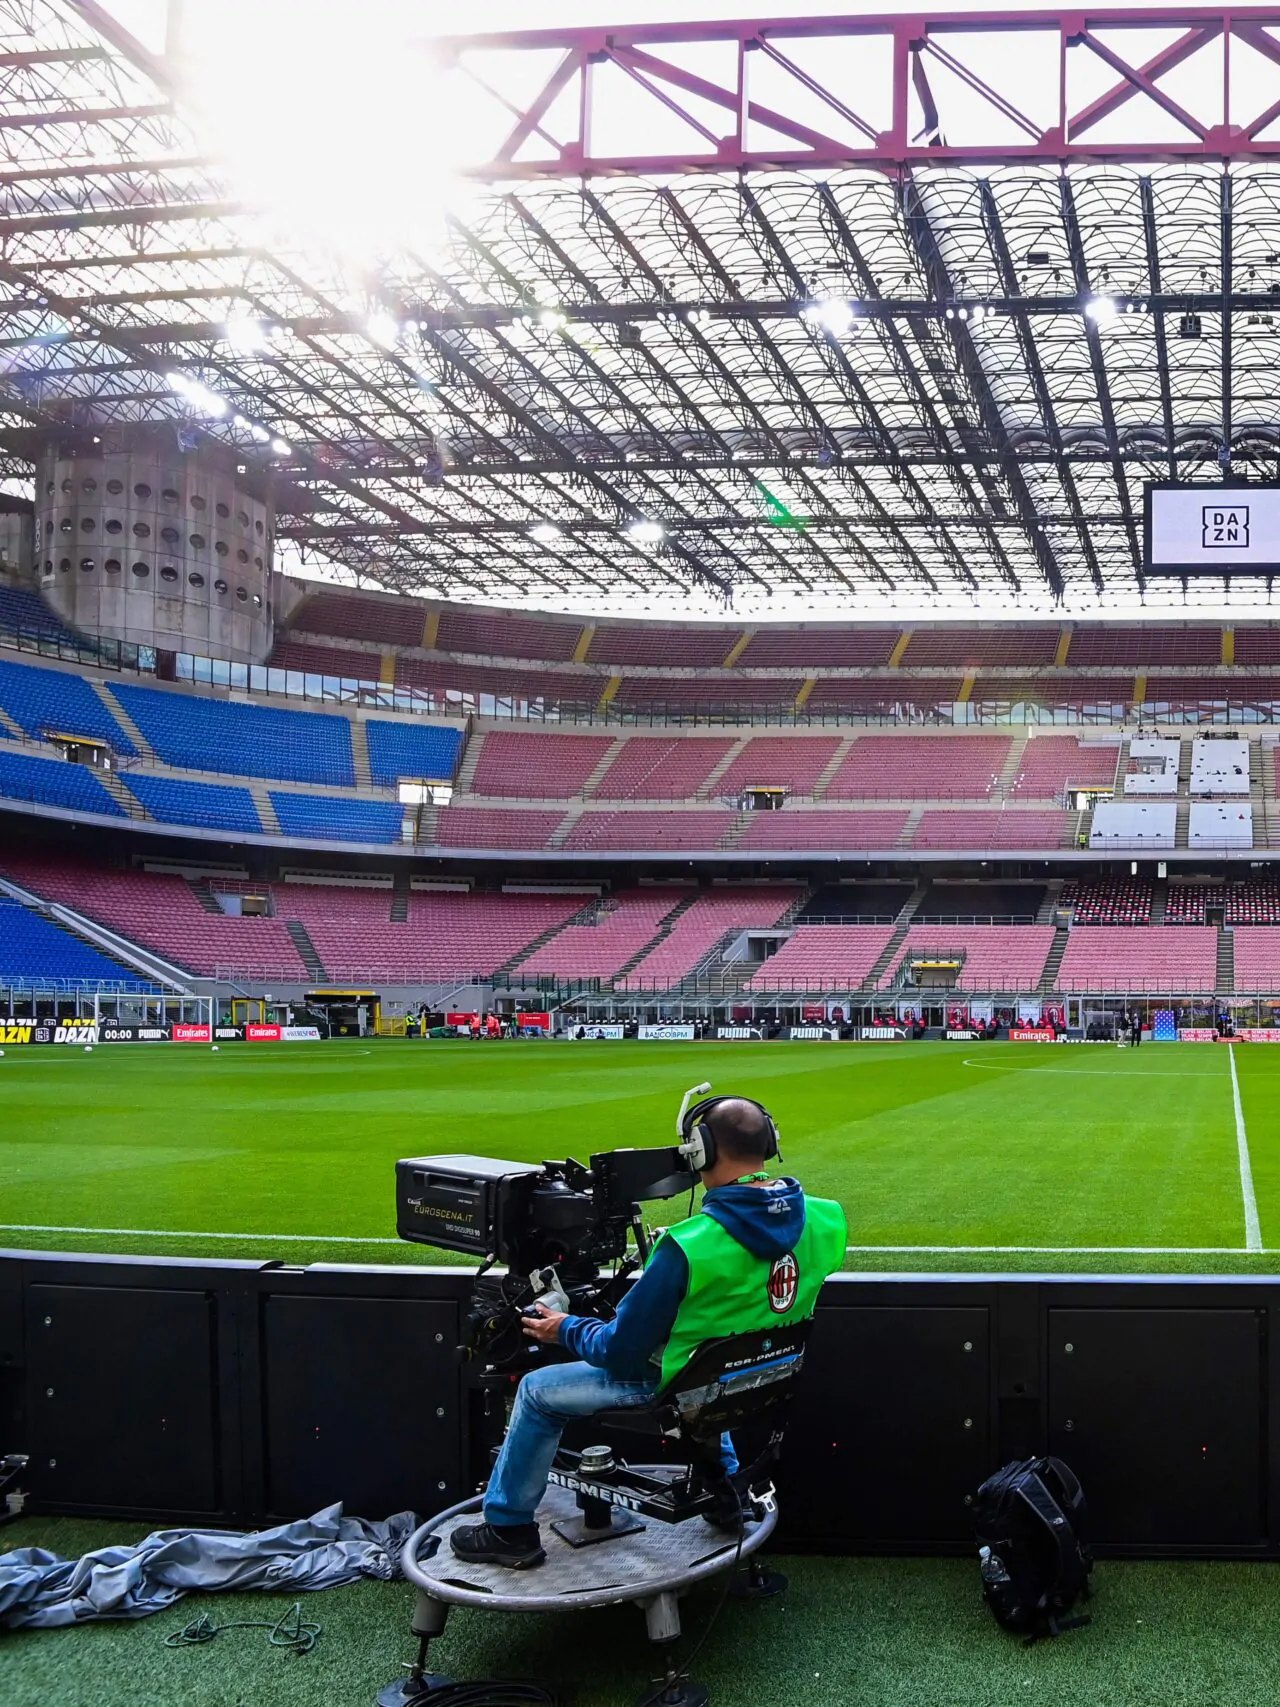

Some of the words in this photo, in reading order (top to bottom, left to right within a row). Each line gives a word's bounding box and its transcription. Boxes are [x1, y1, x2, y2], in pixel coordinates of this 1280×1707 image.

[54, 1026, 100, 1043] DAZN
[105, 1029, 132, 1039] 00:00
[138, 1029, 162, 1039] PUMA
[176, 1028, 208, 1038] Emirates
[250, 1028, 278, 1037] Emirates
[717, 1027, 750, 1039] PUMA
[790, 1027, 822, 1039] PUMA
[861, 1027, 895, 1039] PUMA
[946, 1031, 972, 1040] PUMA
[1013, 1031, 1050, 1040] Emirates
[414, 1204, 474, 1223] EUROSCENA.IT
[776, 1254, 794, 1269] ACM
[547, 1471, 643, 1512] RIPMENT
